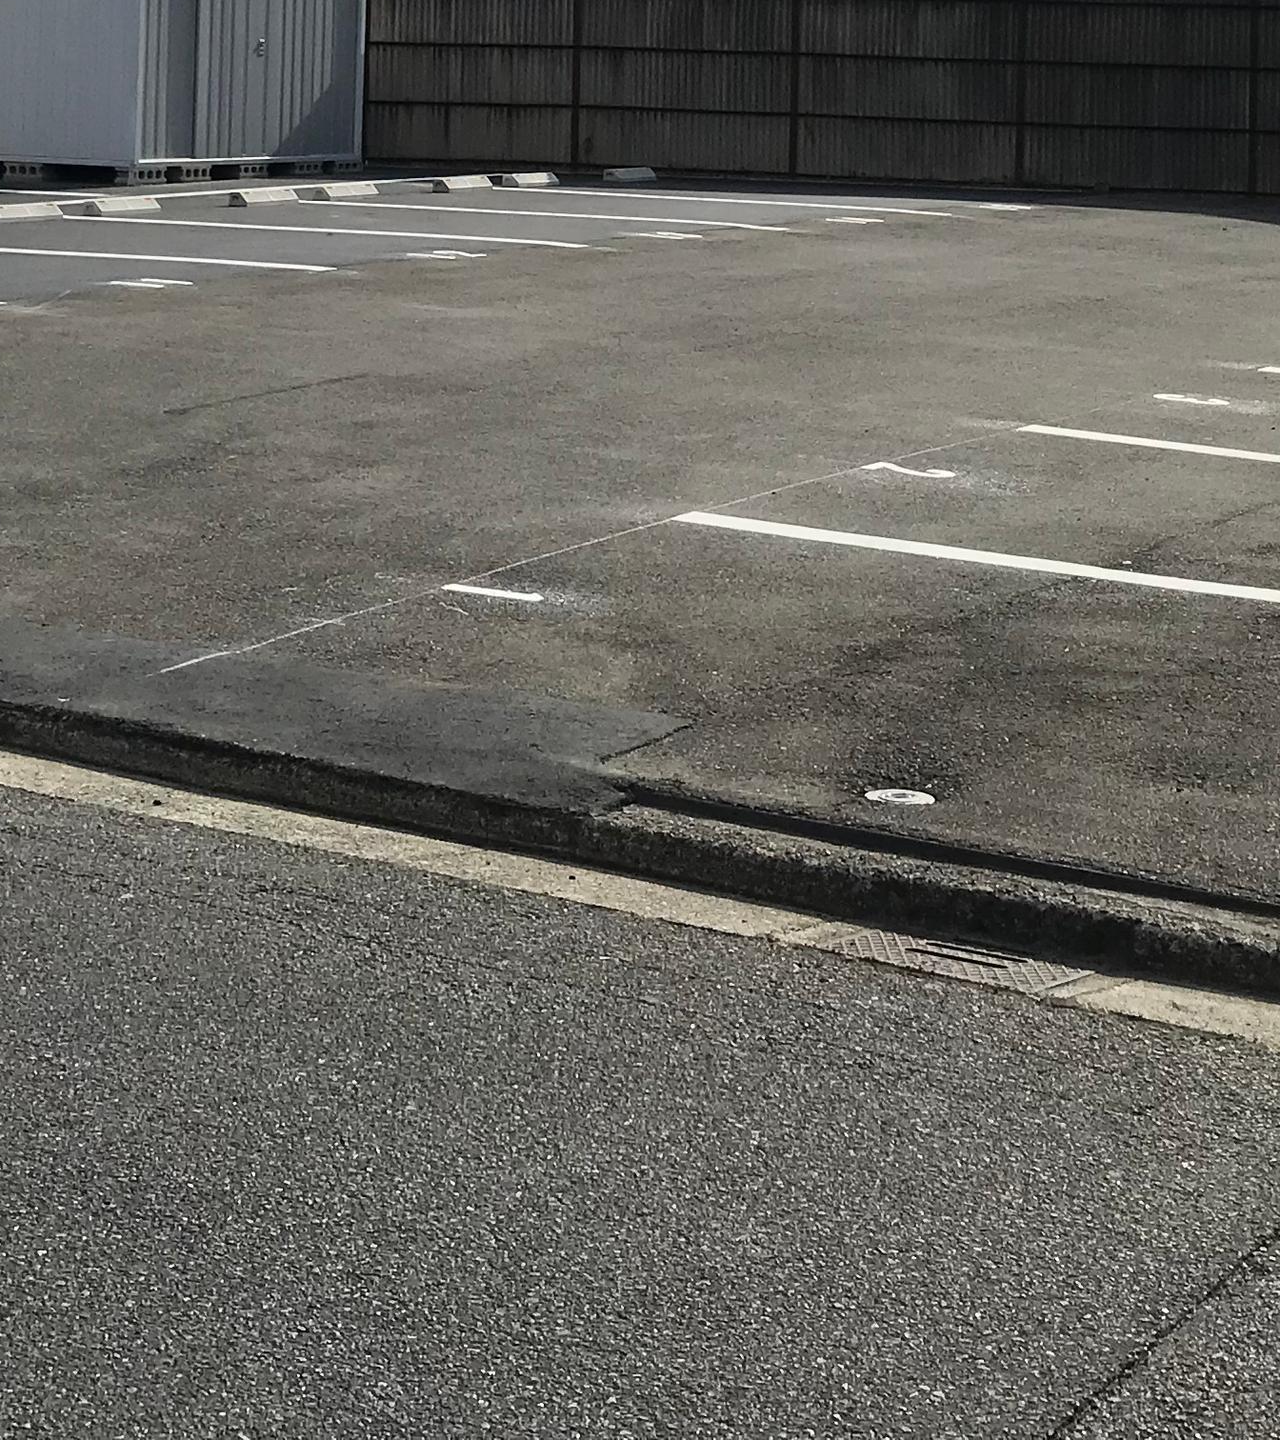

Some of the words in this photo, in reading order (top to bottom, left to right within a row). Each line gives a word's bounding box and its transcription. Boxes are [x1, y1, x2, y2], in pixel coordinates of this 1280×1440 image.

[1152, 393, 1231, 406] 3
[860, 461, 957, 478] 2
[440, 583, 545, 602] 1
